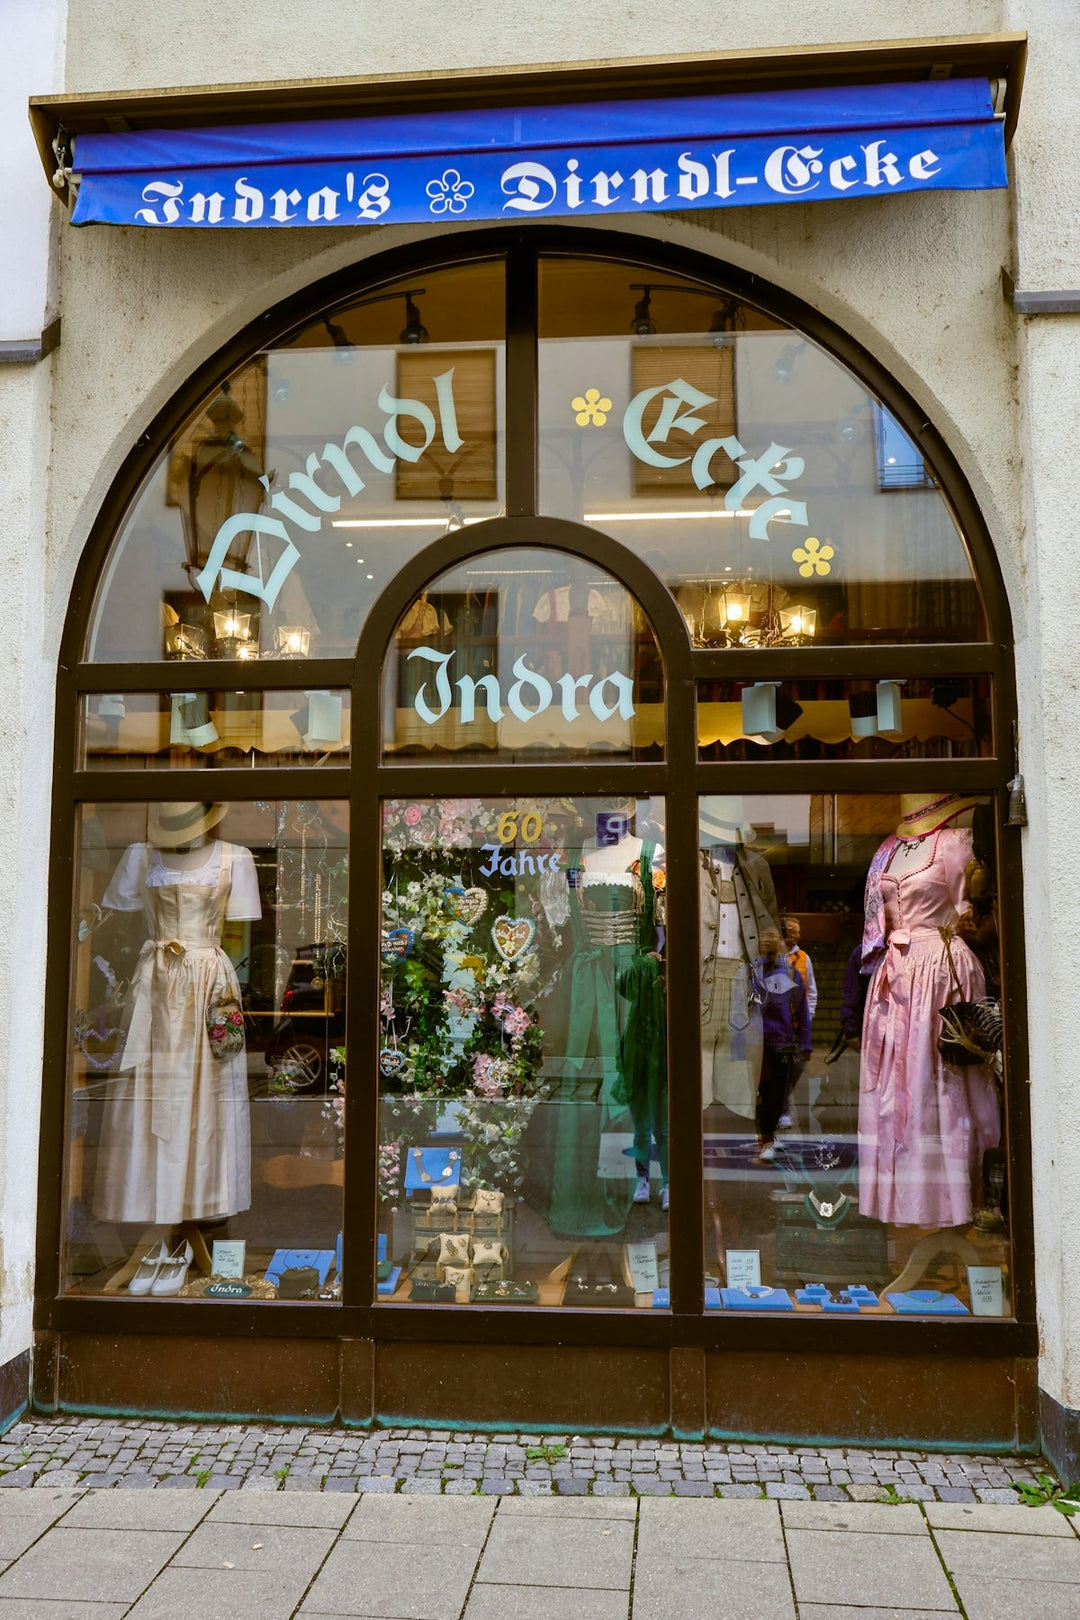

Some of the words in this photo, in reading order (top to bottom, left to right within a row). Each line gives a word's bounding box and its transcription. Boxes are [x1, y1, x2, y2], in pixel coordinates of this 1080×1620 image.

[134, 172, 392, 226] Indra's
[501, 139, 942, 214] Dirndl-Ecke
[196, 367, 465, 614] Dirndl
[623, 378, 809, 541] Ecke
[406, 646, 637, 725] Indra
[480, 843, 562, 877] Jahre
[497, 811, 543, 844] 60
[210, 1283, 243, 1294] Indra
